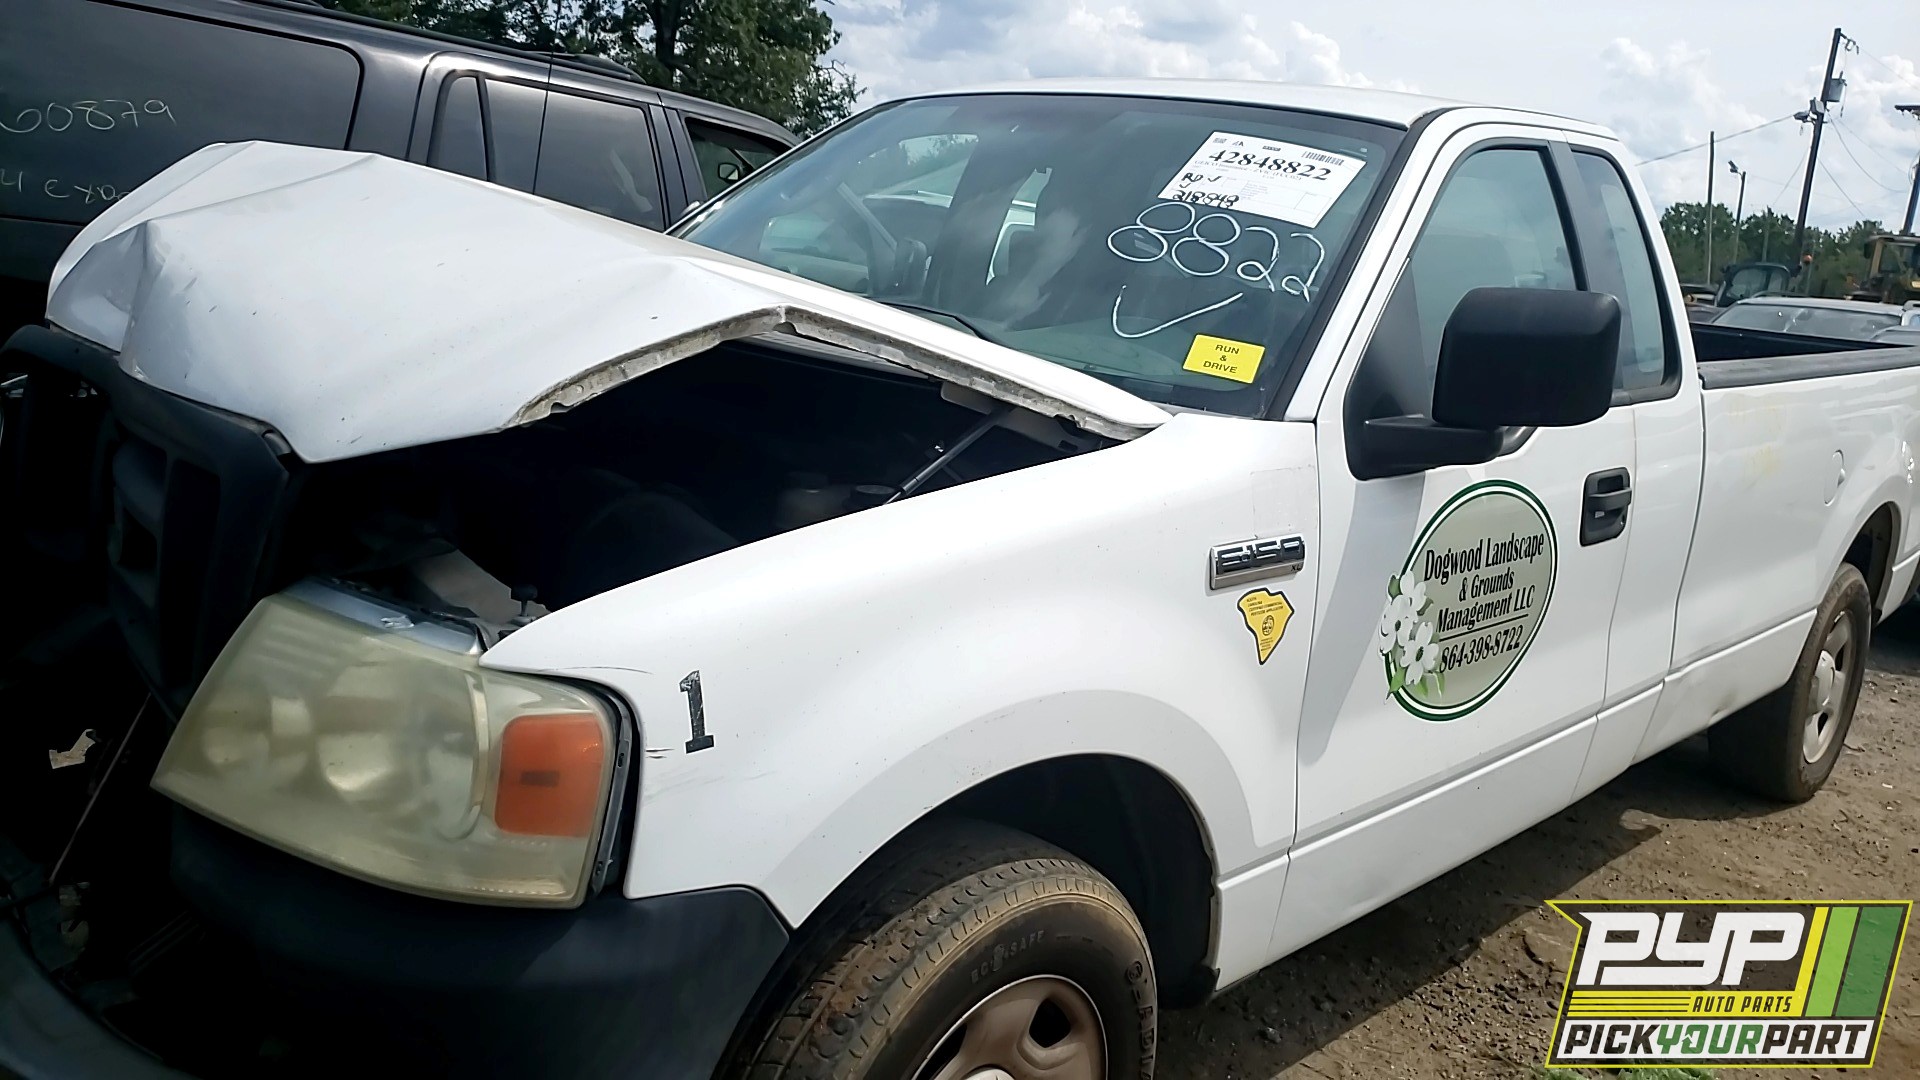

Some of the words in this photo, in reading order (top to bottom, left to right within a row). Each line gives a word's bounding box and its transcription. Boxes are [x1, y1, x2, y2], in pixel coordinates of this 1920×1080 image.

[1209, 149, 1332, 182] 42848822
[1107, 201, 1326, 302] 8822
[1203, 360, 1238, 374] DRIVE
[1215, 344, 1240, 355] RUN
[1219, 354, 1228, 362] &
[1424, 539, 1484, 585] Dogwood
[1485, 532, 1545, 564] Landscape
[1458, 577, 1468, 602] &
[1471, 567, 1515, 598] Grounds
[1436, 592, 1513, 634] Management
[1514, 585, 1536, 613] LLC
[1439, 624, 1524, 674] 864-398-8722
[679, 669, 715, 754] 1
